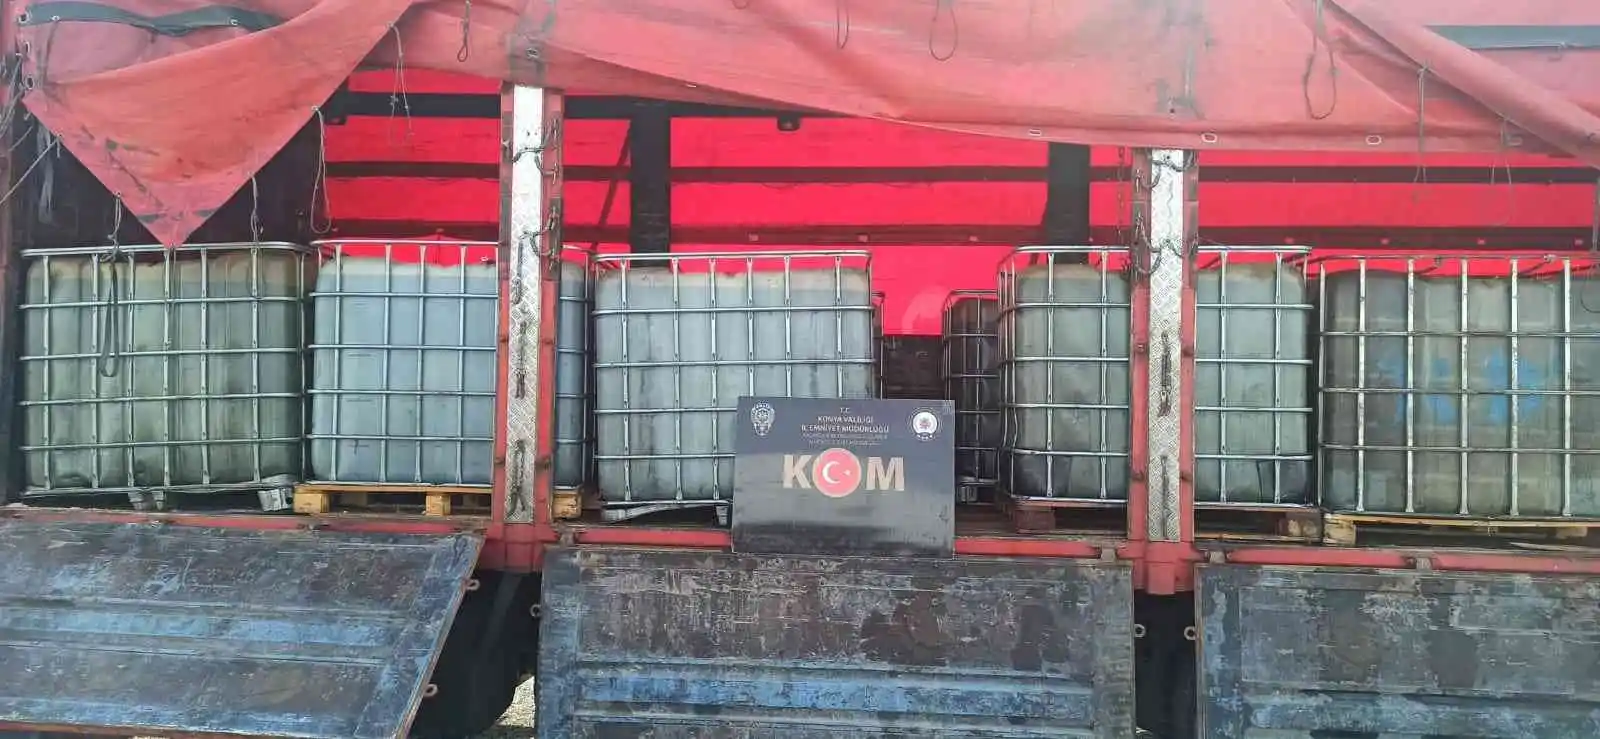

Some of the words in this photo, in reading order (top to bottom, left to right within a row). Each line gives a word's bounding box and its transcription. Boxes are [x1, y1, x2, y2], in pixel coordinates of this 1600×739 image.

[818, 416, 841, 424] KONYA
[809, 423, 840, 433] EMNİYET
[783, 448, 905, 498] KOM
